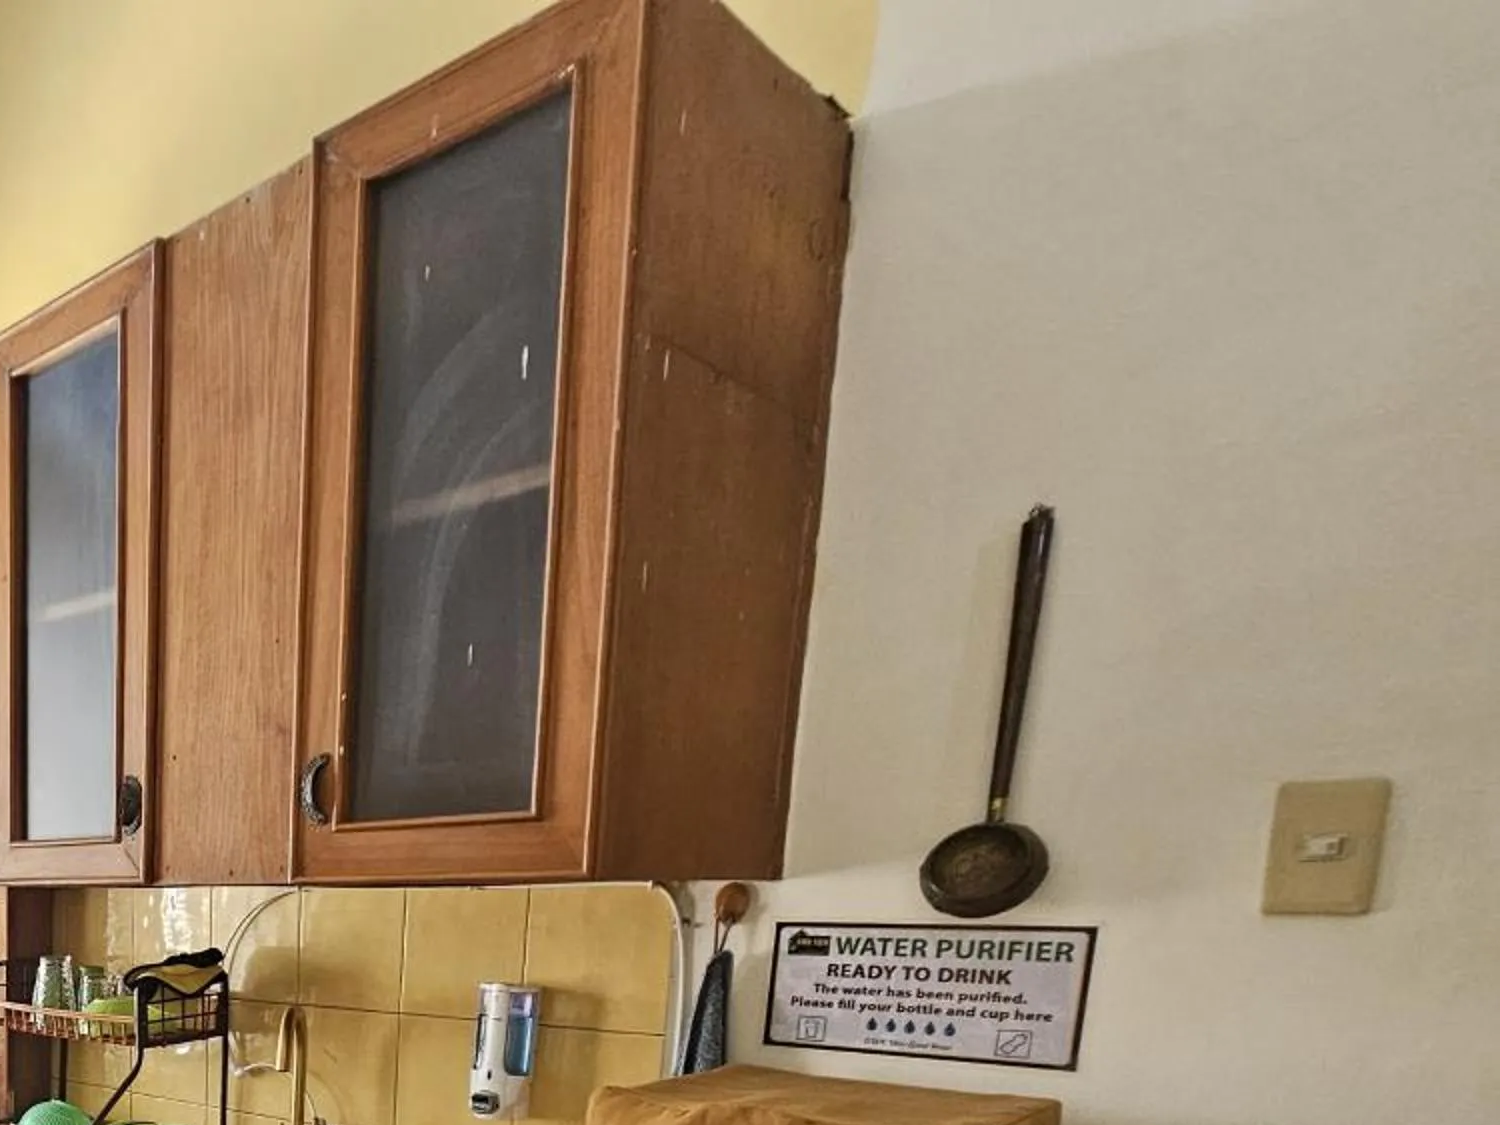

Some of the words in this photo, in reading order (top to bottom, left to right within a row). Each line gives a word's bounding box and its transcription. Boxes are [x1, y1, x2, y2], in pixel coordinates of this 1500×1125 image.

[836, 936, 927, 958] WATER
[935, 939, 1075, 963] PURIFIER
[826, 963, 896, 980] READY
[902, 966, 931, 981] TO
[937, 967, 1012, 985] DRINK
[814, 983, 839, 995] The
[842, 986, 883, 996] water
[886, 986, 912, 998] has
[916, 988, 953, 1000] been
[957, 990, 1028, 1005] purified.
[790, 995, 834, 1009] Please
[838, 998, 856, 1010] fill
[859, 1003, 892, 1014] your
[896, 1002, 942, 1015] bottle
[946, 1006, 976, 1017] and
[980, 1009, 1009, 1022] cup
[1014, 1009, 1053, 1022] here
